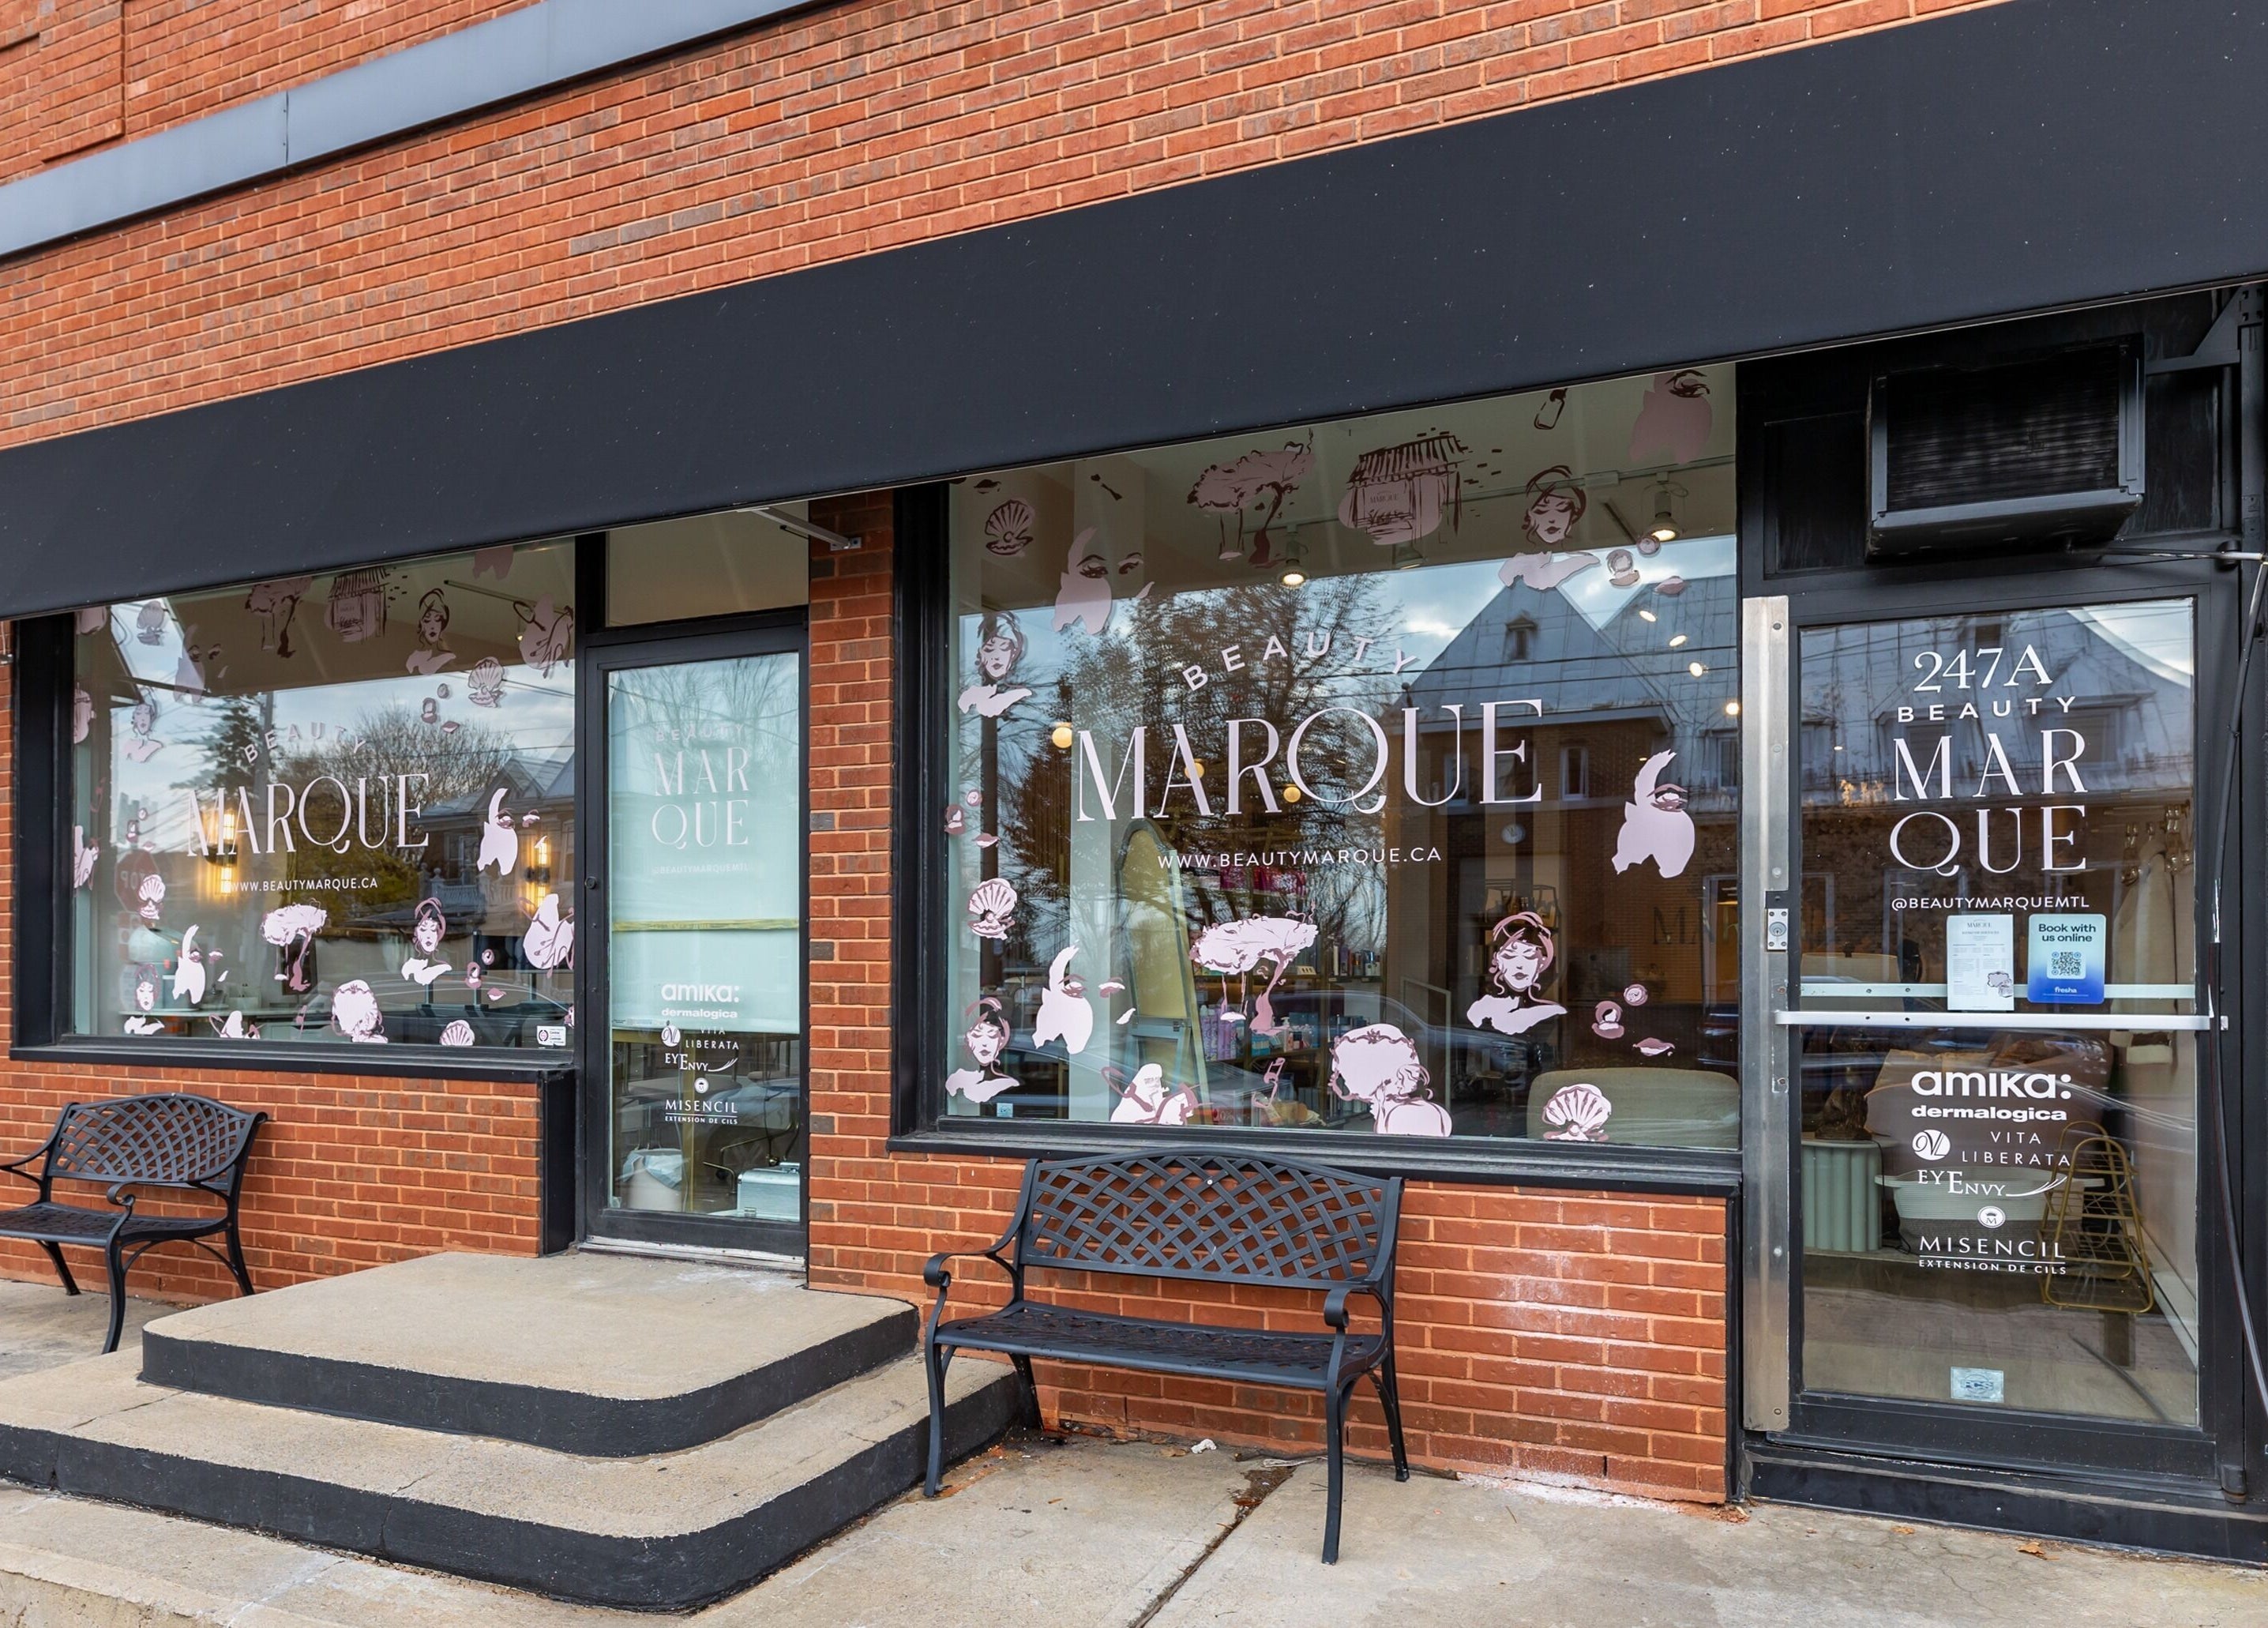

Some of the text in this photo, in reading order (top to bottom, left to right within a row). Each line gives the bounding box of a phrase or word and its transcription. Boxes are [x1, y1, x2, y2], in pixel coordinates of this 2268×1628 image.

[1182, 631, 1418, 691] BEAUTY
[1913, 644, 2053, 694] 247A
[1897, 696, 2076, 723] BEAUTY
[243, 721, 367, 764] BEAUTY
[1077, 698, 1542, 822] MARQUE
[1893, 728, 2088, 801] MAR
[654, 746, 749, 797] MAR
[186, 773, 430, 857] MARQUE
[651, 799, 749, 850] QUE
[1890, 805, 2087, 877] QUE
[1158, 847, 1442, 868] WWW.BEAUTYMARQUE.CA
[1891, 896, 2090, 912] @BEAUTYMARQUEMTL
[2038, 923, 2097, 933] Book with
[2057, 933, 2093, 942] online
[661, 983, 739, 1003] amika:
[661, 1007, 738, 1020] dermalogica
[685, 1040, 739, 1050] LIBERATA
[1911, 1070, 2071, 1100] amika:
[665, 1099, 738, 1113] MISENCIL
[1911, 1105, 2067, 1122] dermalogica
[1990, 1131, 2041, 1145] VITA
[1962, 1151, 2071, 1166] LIBERATA
[1919, 1235, 2066, 1258] MISENCIL
[1919, 1260, 2000, 1271] EXTENSION
[2034, 1265, 2067, 1274] CILS
